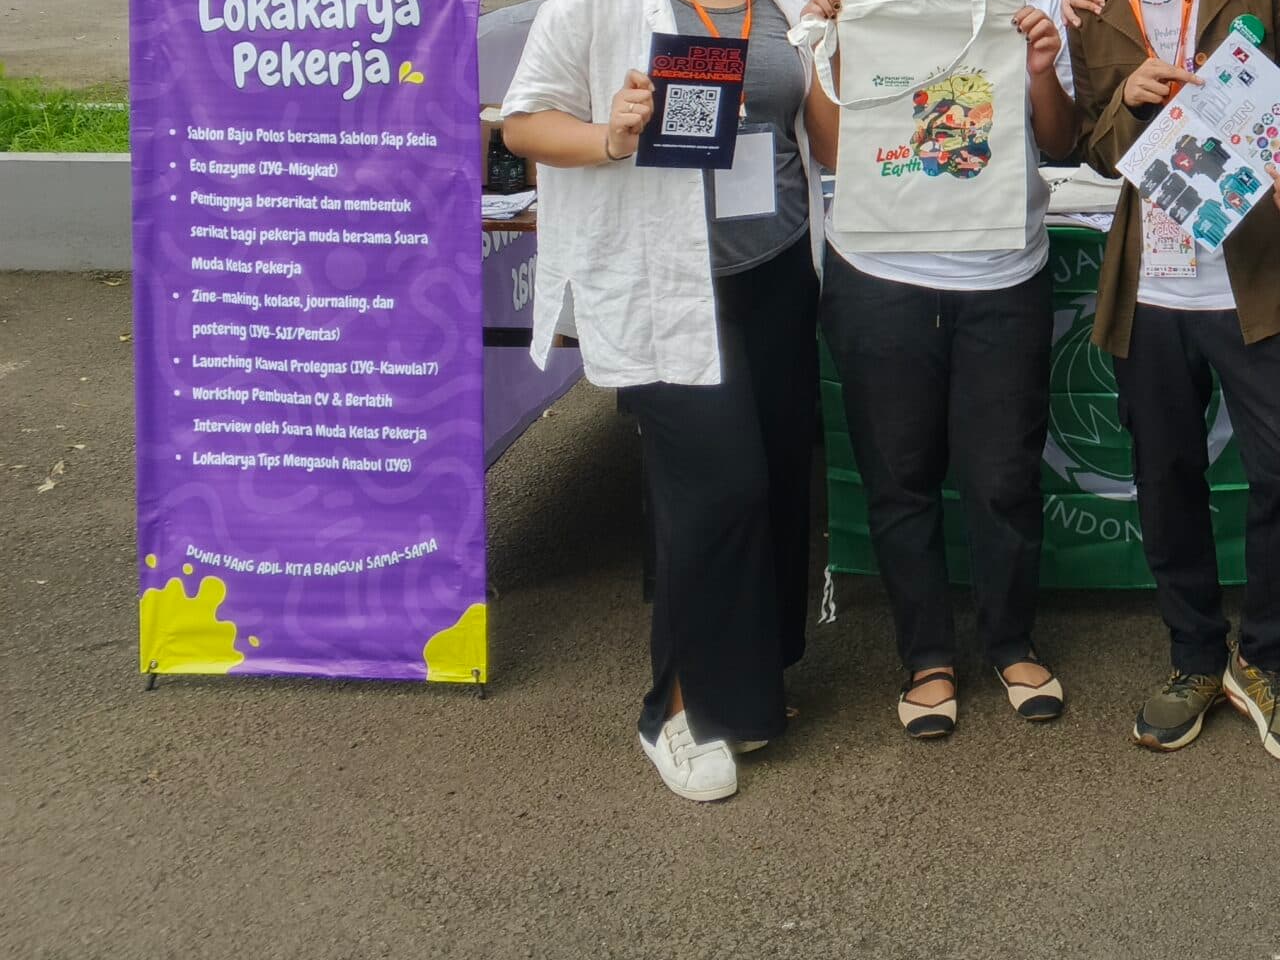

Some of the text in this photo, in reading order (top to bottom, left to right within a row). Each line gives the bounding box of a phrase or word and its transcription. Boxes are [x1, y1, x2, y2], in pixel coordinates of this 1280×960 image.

[652, 55, 744, 74] ORDER
[689, 46, 742, 62] PRE
[232, 40, 392, 101] Pekerja
[652, 69, 742, 81] MERCHANDISE
[1220, 99, 1256, 137] PIN
[188, 126, 437, 149] Sablon Baju Polos bersama Sablon Siap Sedia
[876, 145, 912, 164] Love
[190, 158, 338, 179] Eco Enzyme (IYG-Misykat)
[881, 157, 923, 178] Earth
[191, 191, 411, 213] Pentingnya berserikat dan membentuk
[190, 224, 428, 246] serikat bagi pekerja muda bersama Suara
[191, 257, 302, 278] Muda Kelas Pekerja
[192, 289, 394, 313] Zine-making, kolase, journaling, dan
[192, 323, 246, 341] postering
[192, 354, 252, 373] Launching
[255, 356, 288, 372] Kawal
[290, 358, 347, 377] Prolegnas
[192, 387, 393, 408] Workshop Pembuatan CV & Berlatih
[193, 418, 427, 444] Interview oleh Suara Muda Kelas Pekerja
[193, 451, 412, 473] Lokakarya Tips Mengasuh Anabul (IYG)
[186, 538, 438, 576] DUNIA YANG ADIL KITA BANGUN SAMA-SAMA
